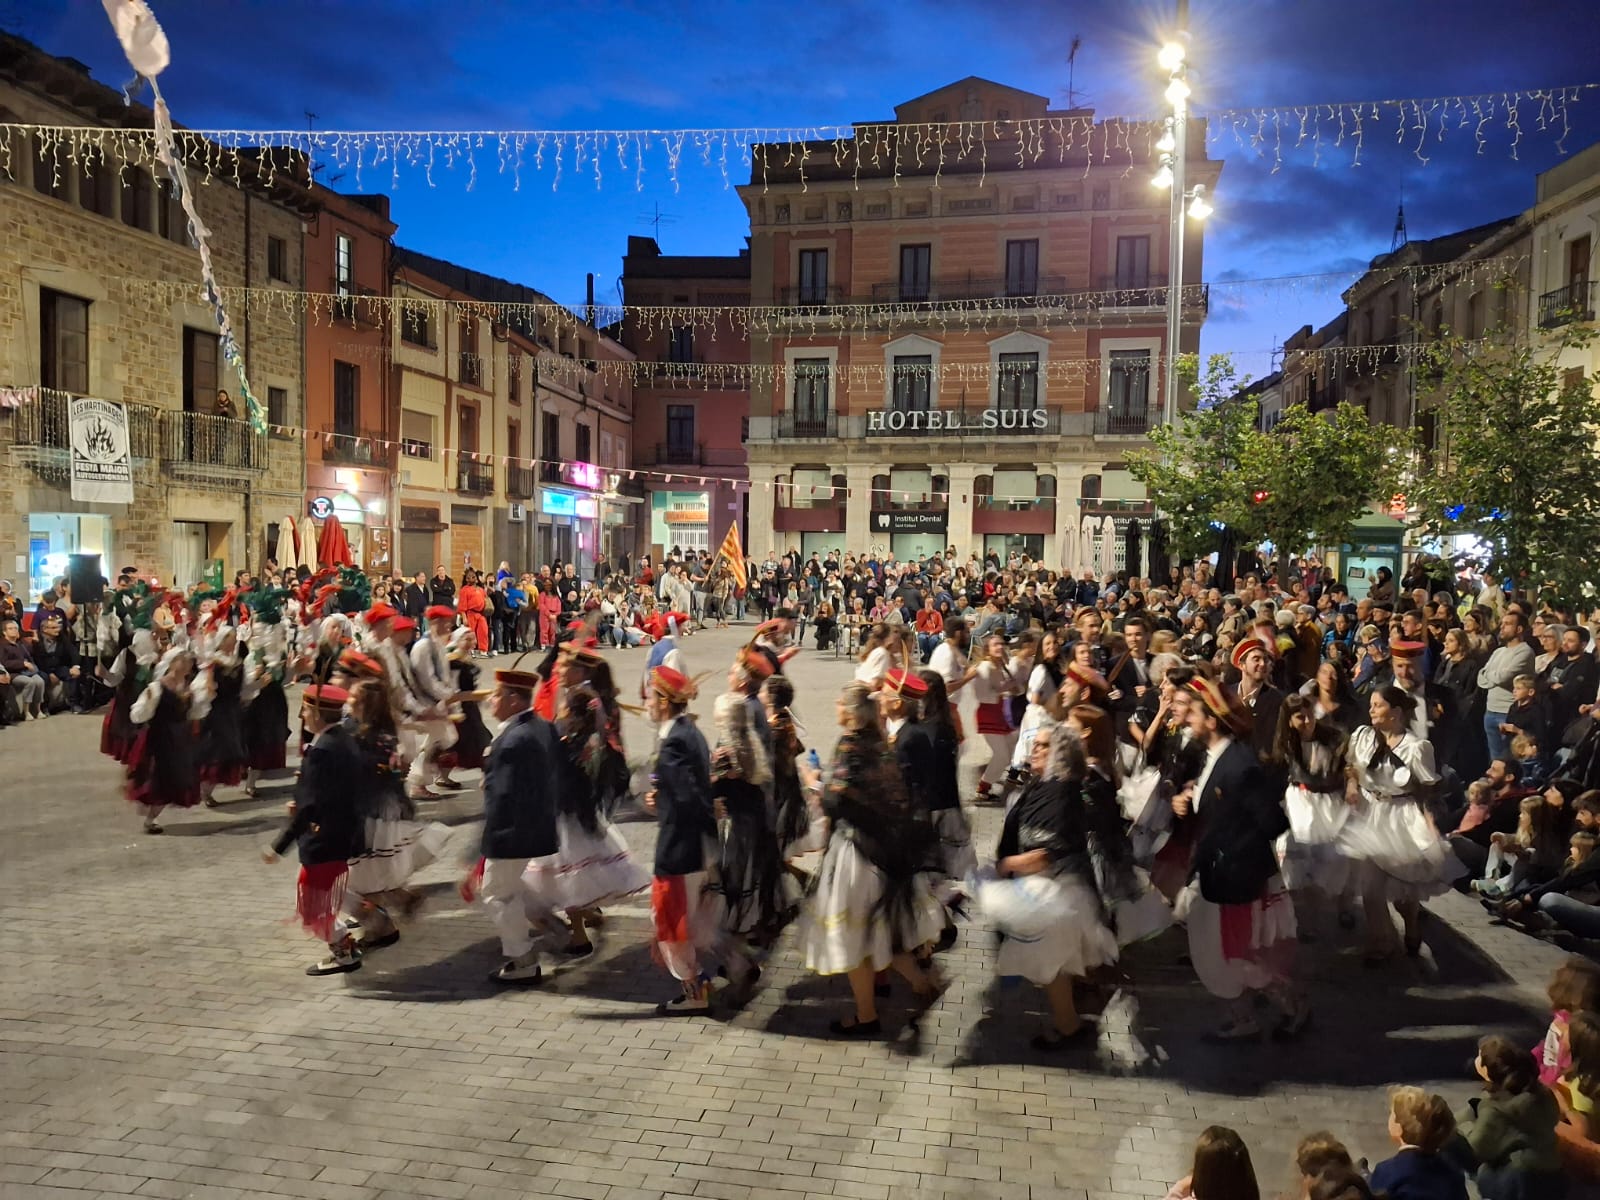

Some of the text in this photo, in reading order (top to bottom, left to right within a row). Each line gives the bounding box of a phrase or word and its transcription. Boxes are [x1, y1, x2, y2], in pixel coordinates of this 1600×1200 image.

[73, 402, 84, 415] LES
[868, 409, 1048, 430] HOTEL SUIS
[75, 462, 129, 475] FESTA MAJOR
